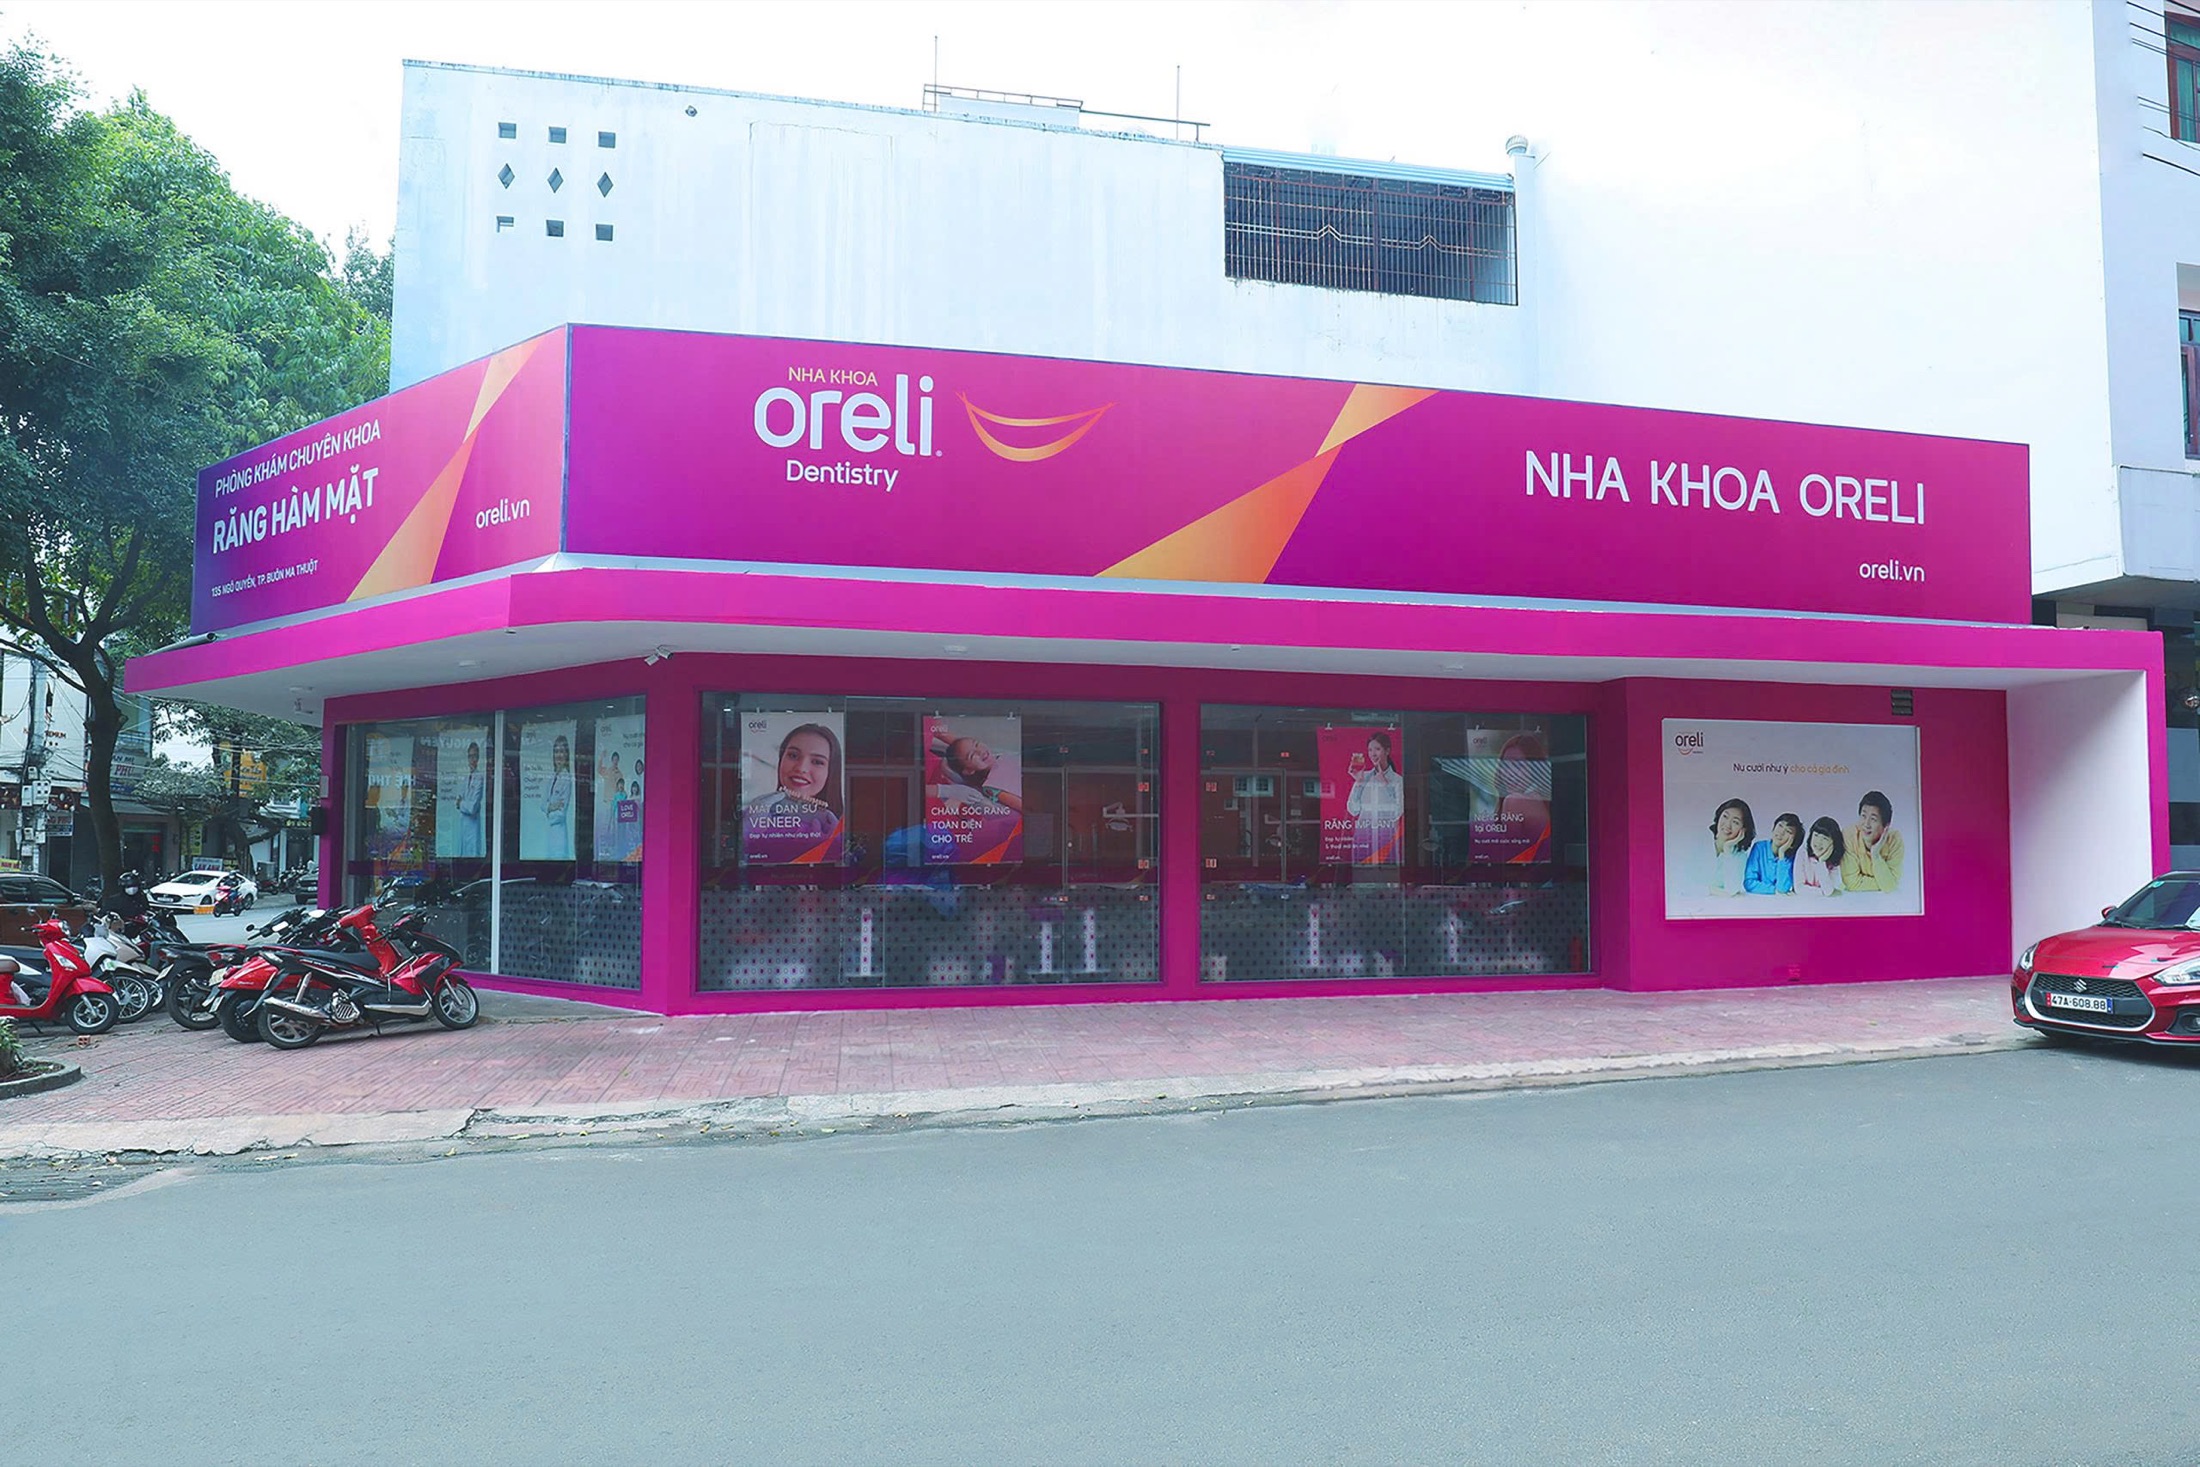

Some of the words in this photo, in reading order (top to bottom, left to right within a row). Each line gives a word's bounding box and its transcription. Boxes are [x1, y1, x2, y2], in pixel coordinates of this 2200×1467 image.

[788, 366, 826, 383] NHA
[830, 369, 878, 386] KHOA
[754, 373, 934, 457] oreli
[215, 467, 253, 498] PHÒNG
[253, 453, 287, 484] KHÁM
[289, 432, 341, 471] CHUYÊN
[343, 419, 381, 451] KHOA
[786, 459, 898, 493] Dentistry
[1525, 449, 1630, 502] NHA
[1650, 459, 1780, 514] KHOA
[1799, 473, 1925, 525] ORELI
[213, 505, 267, 554] RĂNG
[271, 485, 321, 536] HÀM
[325, 463, 379, 525] MẶT
[476, 498, 530, 529] oreli.vn
[1858, 558, 1926, 583] oreli.vn
[1675, 731, 1704, 747] oreli
[749, 816, 802, 828] VENEER
[931, 834, 952, 844] CHO
